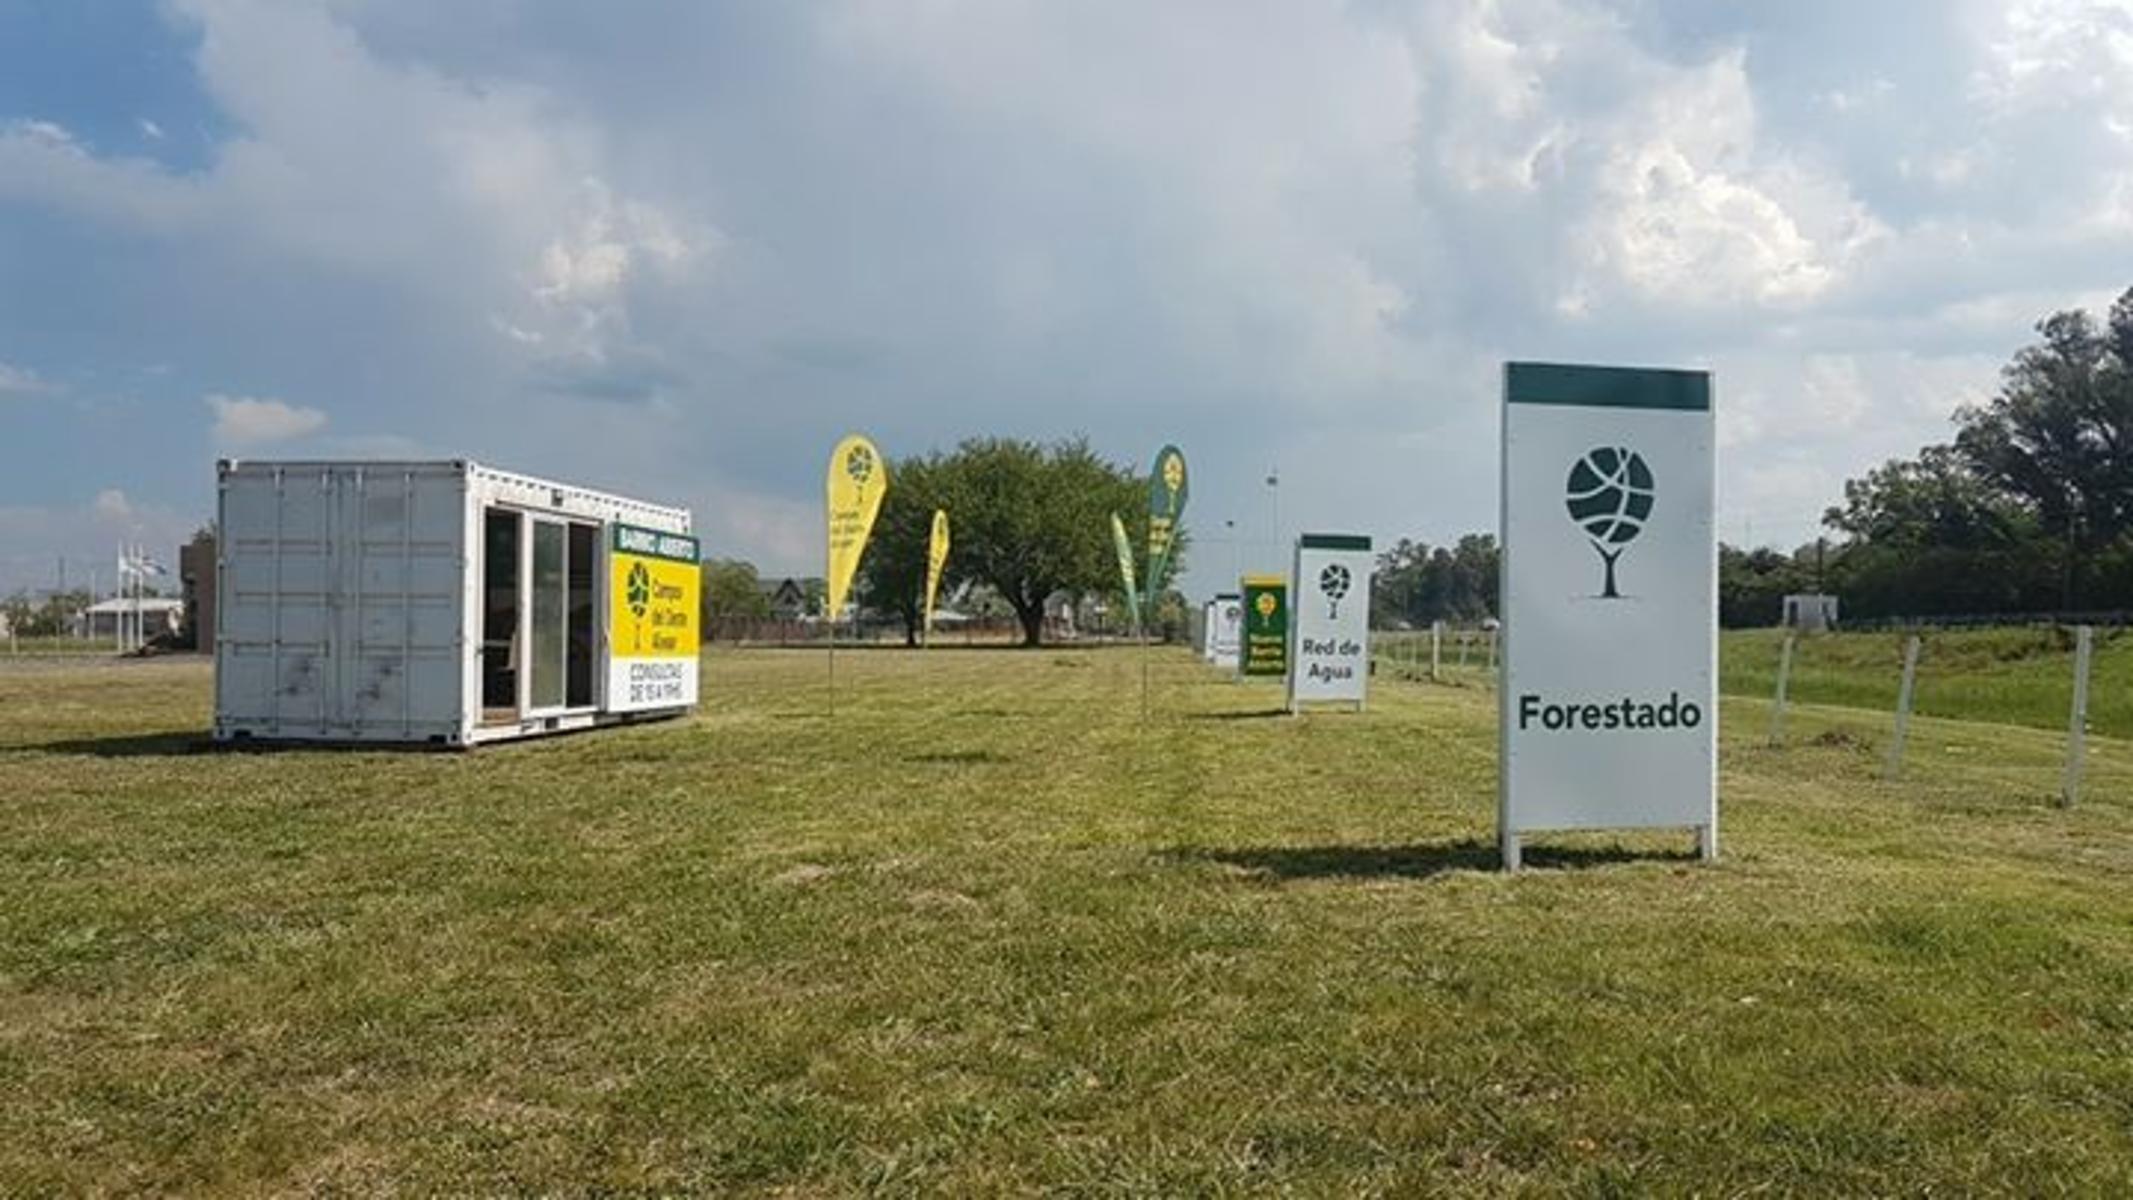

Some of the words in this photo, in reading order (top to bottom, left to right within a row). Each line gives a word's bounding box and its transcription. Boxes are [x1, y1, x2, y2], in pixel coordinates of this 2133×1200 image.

[1302, 637, 1337, 655] Red
[1338, 638, 1361, 656] de
[1307, 662, 1353, 683] Agua
[1519, 690, 1701, 730] Forestado
